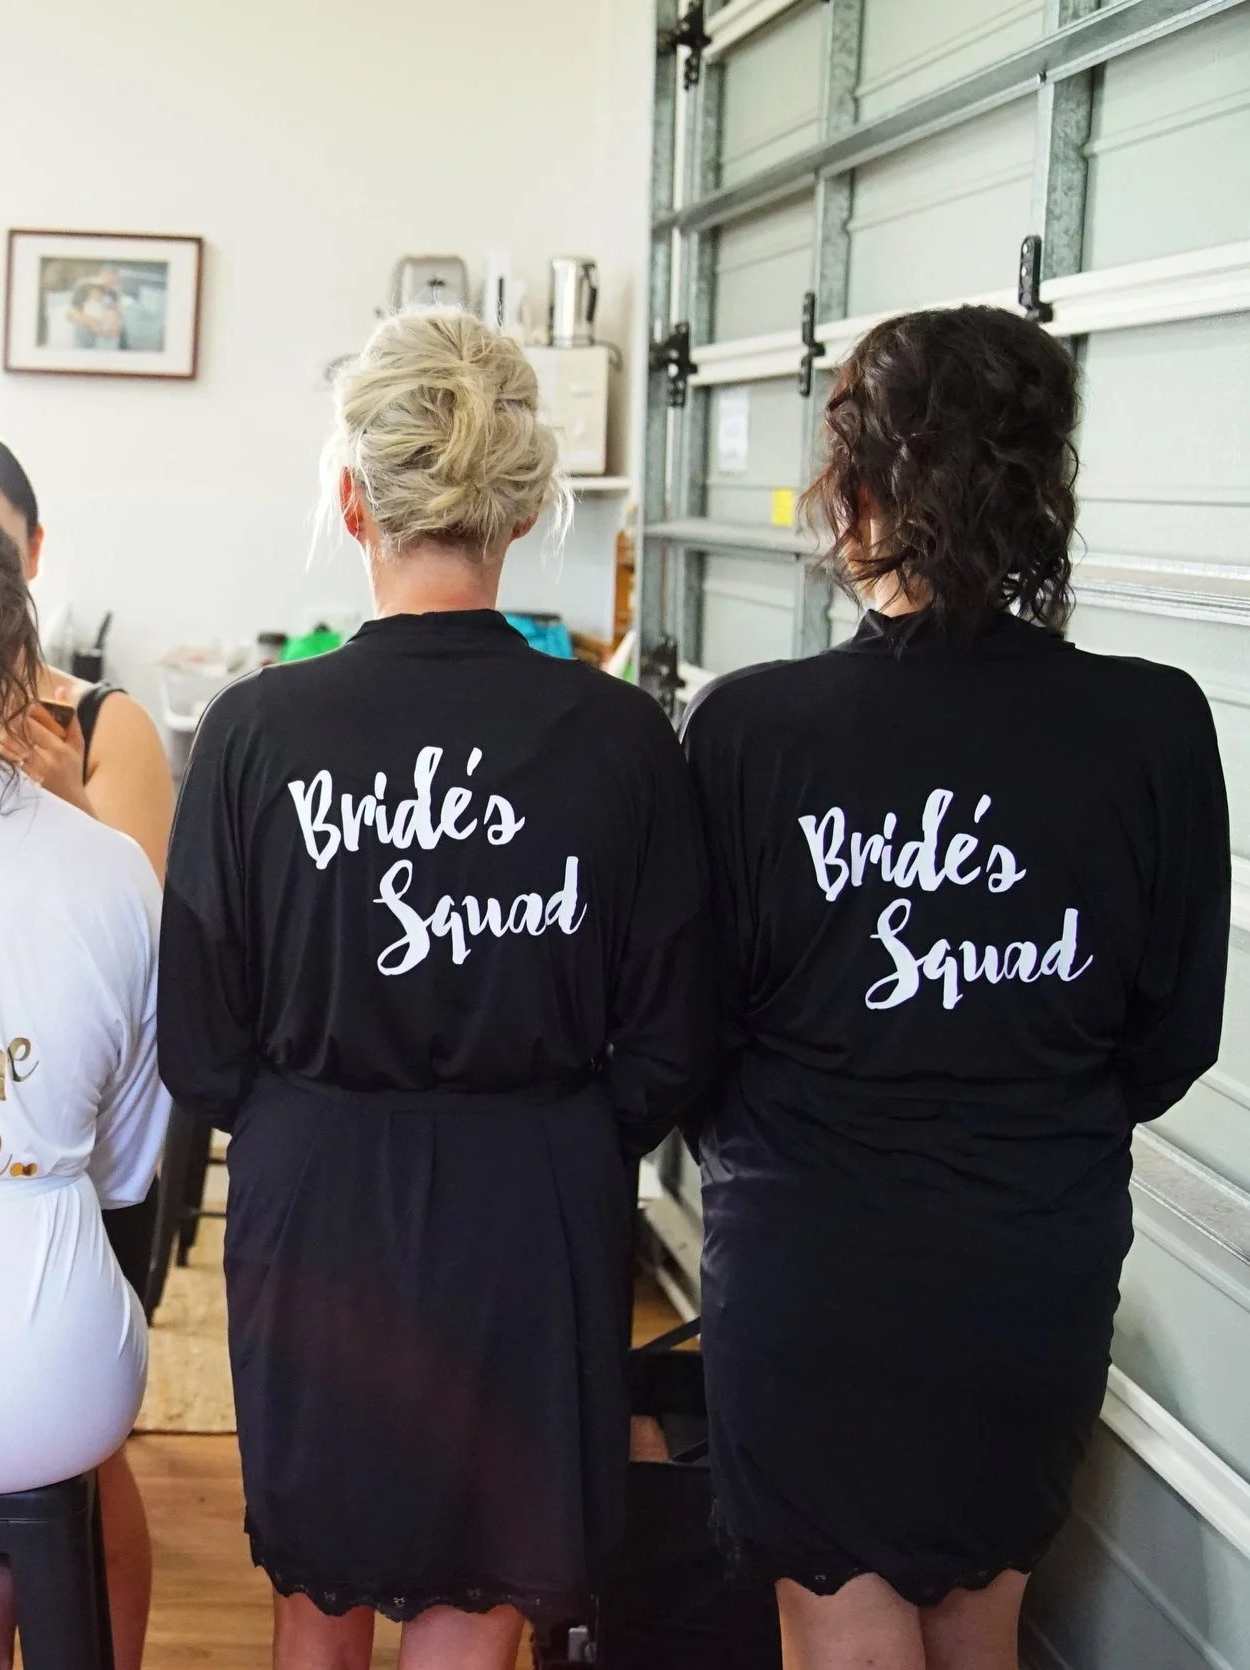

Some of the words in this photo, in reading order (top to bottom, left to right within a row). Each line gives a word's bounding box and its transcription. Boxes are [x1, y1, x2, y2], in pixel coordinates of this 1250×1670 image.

[287, 745, 526, 870] Bride's
[797, 788, 1027, 902] Bride's
[372, 855, 588, 976] Squad
[864, 898, 1094, 1010] Squad
